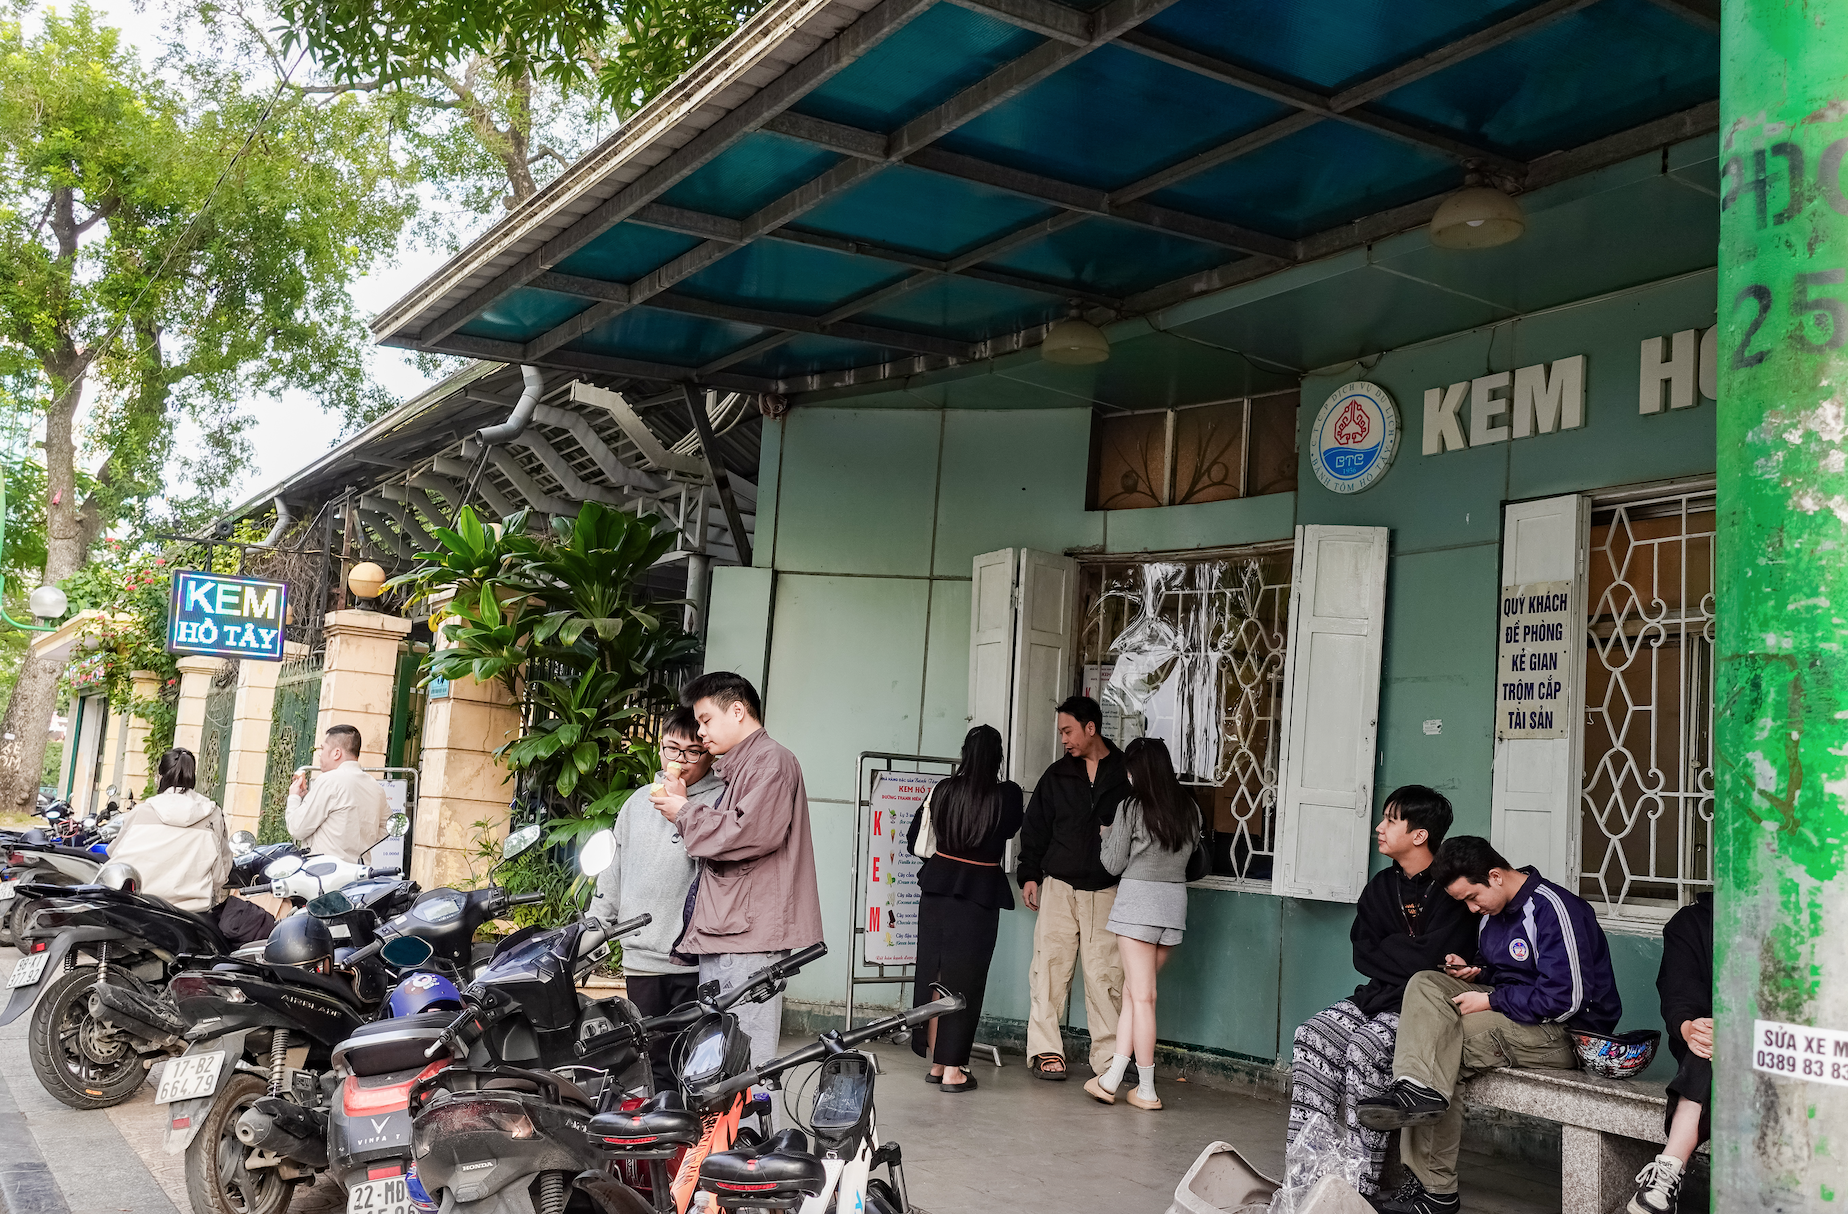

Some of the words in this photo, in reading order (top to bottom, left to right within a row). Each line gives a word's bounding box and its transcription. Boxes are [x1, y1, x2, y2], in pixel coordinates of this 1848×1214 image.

[1375, 389, 1387, 404] DU
[1422, 354, 1587, 456] KEM
[185, 580, 277, 619] KEM
[1528, 591, 1568, 614] KHÁCH
[223, 622, 279, 649] TÂY
[1505, 619, 1521, 643] ĐỀ
[1523, 619, 1563, 642] PHÒNG
[1511, 648, 1526, 671] KẺ
[1529, 652, 1558, 671] GIAN
[1502, 678, 1535, 705] TRỘM
[1538, 674, 1562, 700] CẮP
[1508, 707, 1526, 729] TÀI
[1529, 705, 1553, 729] SẢN
[898, 785, 914, 793] KEM
[202, 1016, 222, 1024] HONDA
[1763, 1025, 1797, 1051] SỬA
[1803, 1036, 1826, 1056] XE
[174, 1056, 215, 1079] 17-B2
[1757, 1050, 1796, 1073] 0389
[1803, 1059, 1824, 1077] 83
[160, 1074, 214, 1100] 664.79
[462, 1161, 494, 1172] HONDA
